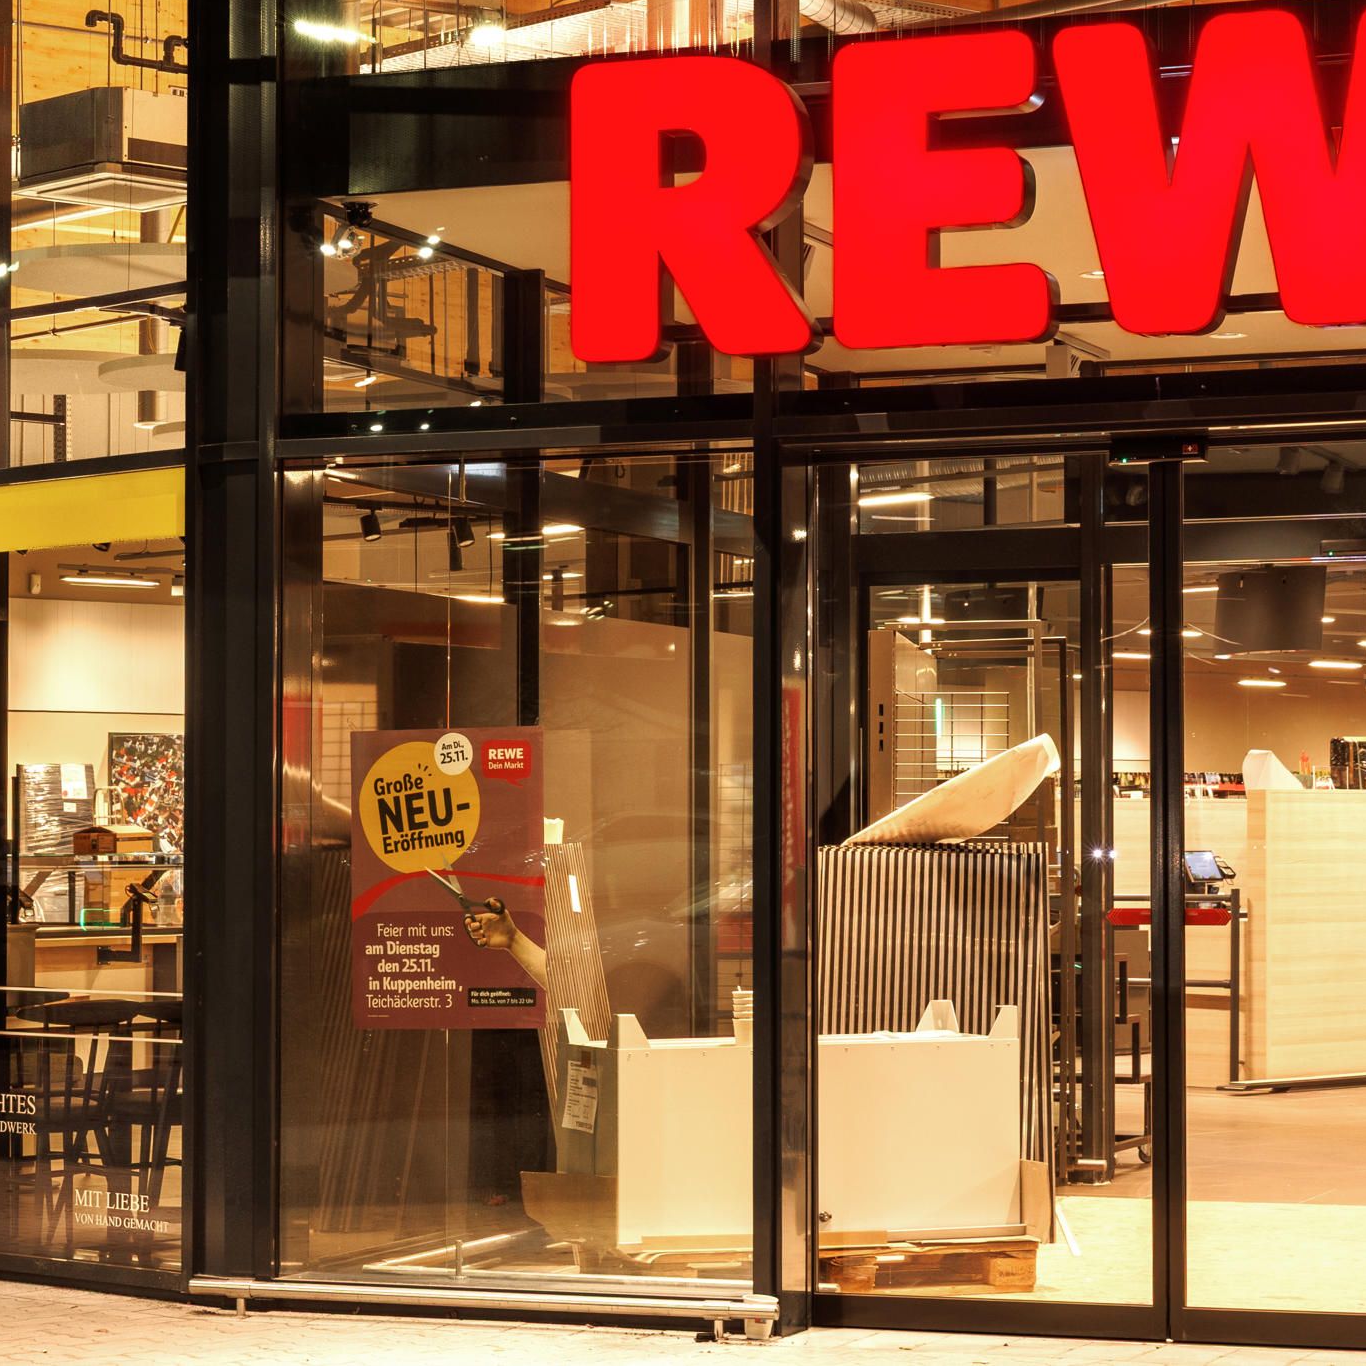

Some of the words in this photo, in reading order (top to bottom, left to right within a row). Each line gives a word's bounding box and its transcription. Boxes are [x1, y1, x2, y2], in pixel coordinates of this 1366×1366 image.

[442, 742, 452, 751] Am
[440, 750, 469, 765] 25.11.
[488, 748, 524, 761] REWE
[488, 762, 502, 770] Dein
[504, 761, 524, 770] Markt
[373, 773, 424, 796] Große
[377, 788, 470, 835] NEU-
[382, 828, 465, 854] Eröffnung
[377, 924, 404, 937] Feier
[408, 924, 427, 937] mit
[431, 925, 454, 937] uns:
[365, 944, 384, 955] am
[386, 941, 440, 958] Dienstag
[377, 959, 400, 972] den
[402, 959, 435, 973] 25.11.
[368, 977, 380, 990] in
[367, 994, 441, 1009] Teichäckerstr.
[445, 995, 453, 1008] 3
[74, 1189, 103, 1209] MIT
[106, 1191, 150, 1212] LIEBE
[74, 1213, 94, 1225] VON
[95, 1214, 122, 1228] HAND
[123, 1217, 170, 1232] GEMACHT
